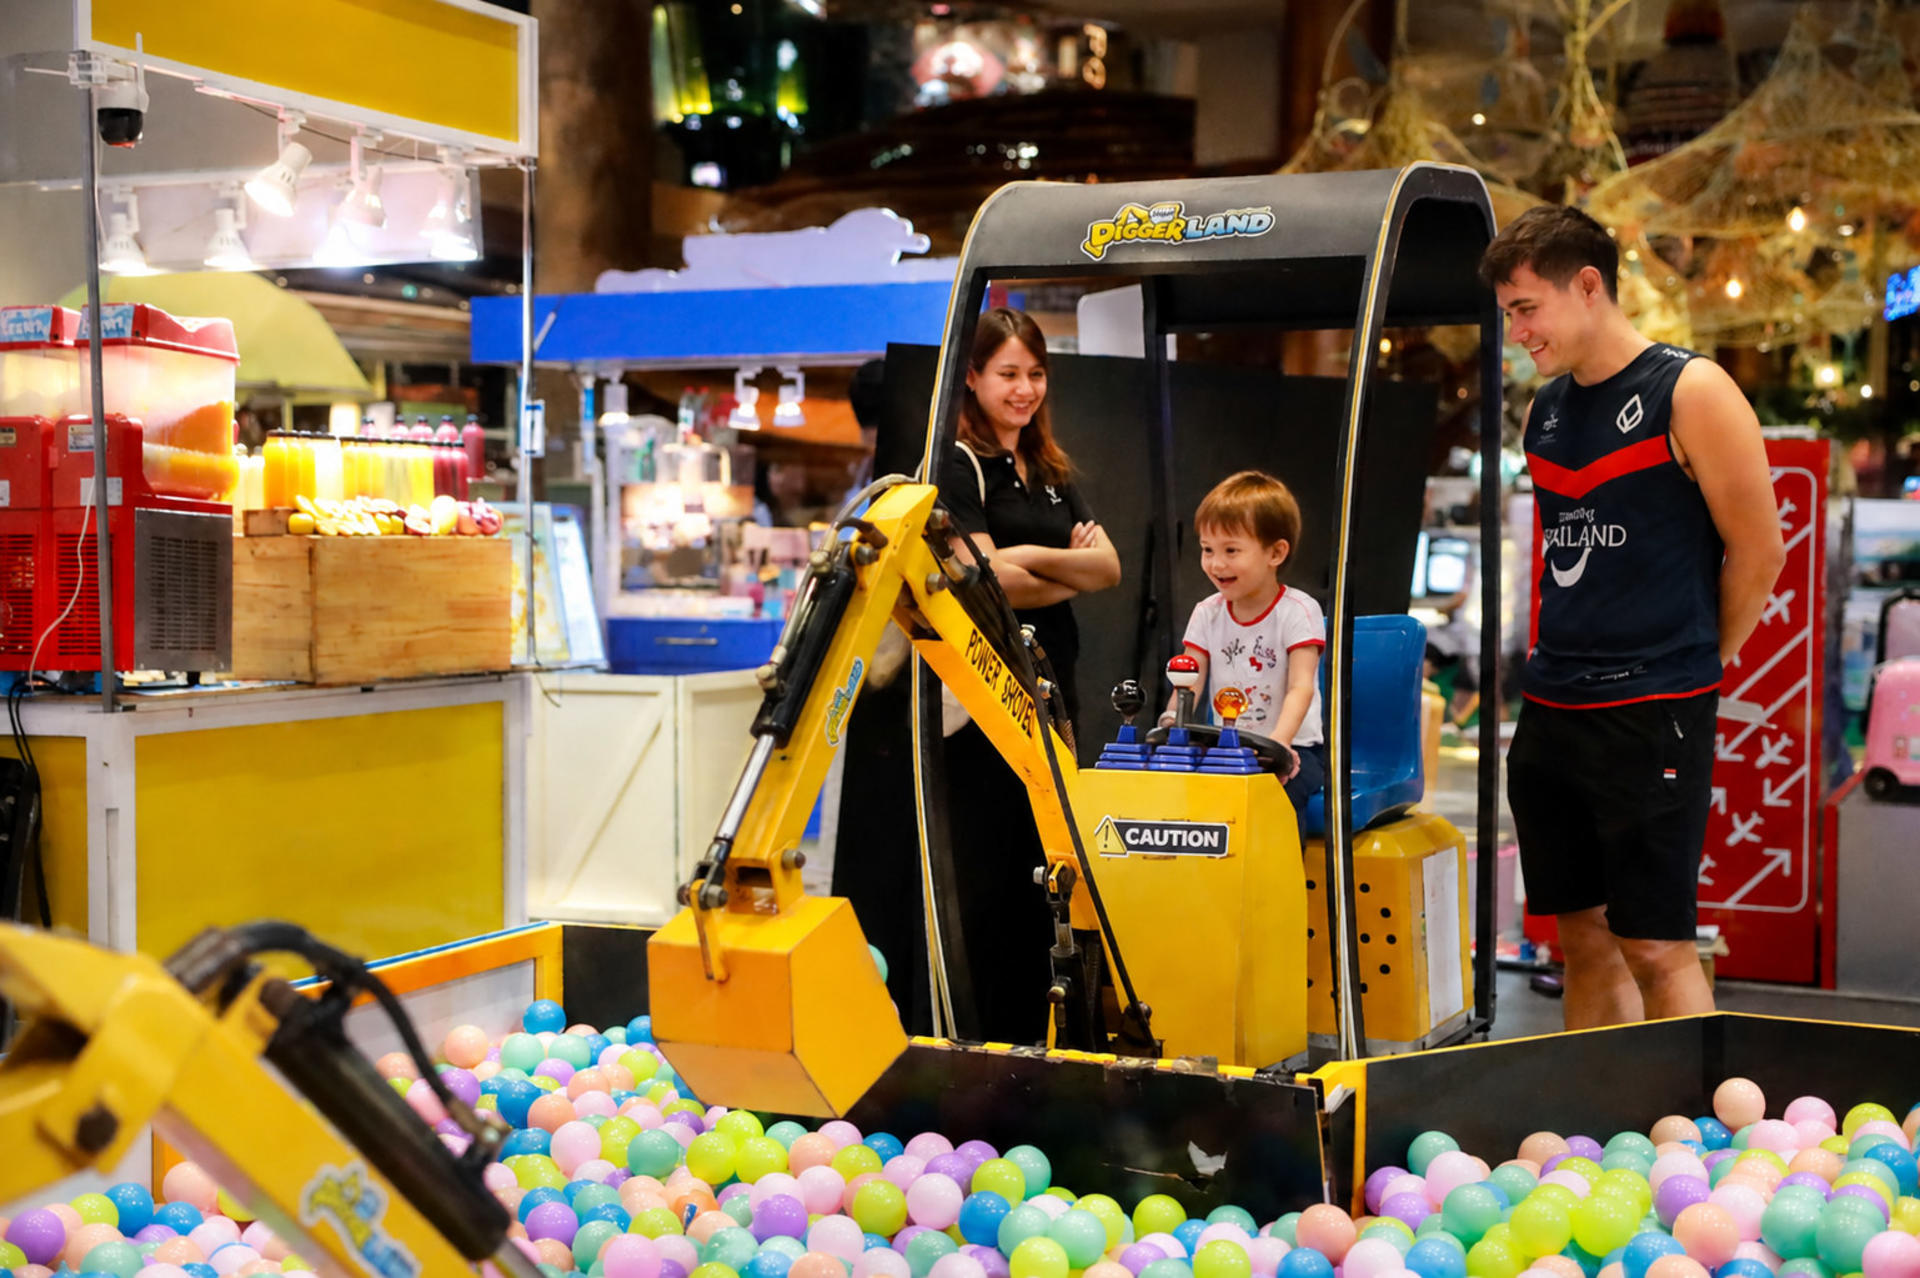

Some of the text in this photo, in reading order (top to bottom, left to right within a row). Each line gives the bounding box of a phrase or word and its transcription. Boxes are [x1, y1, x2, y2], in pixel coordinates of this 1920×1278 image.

[965, 628, 1036, 739] POWER SHOVEL
[1124, 827, 1220, 848] CAUTION
